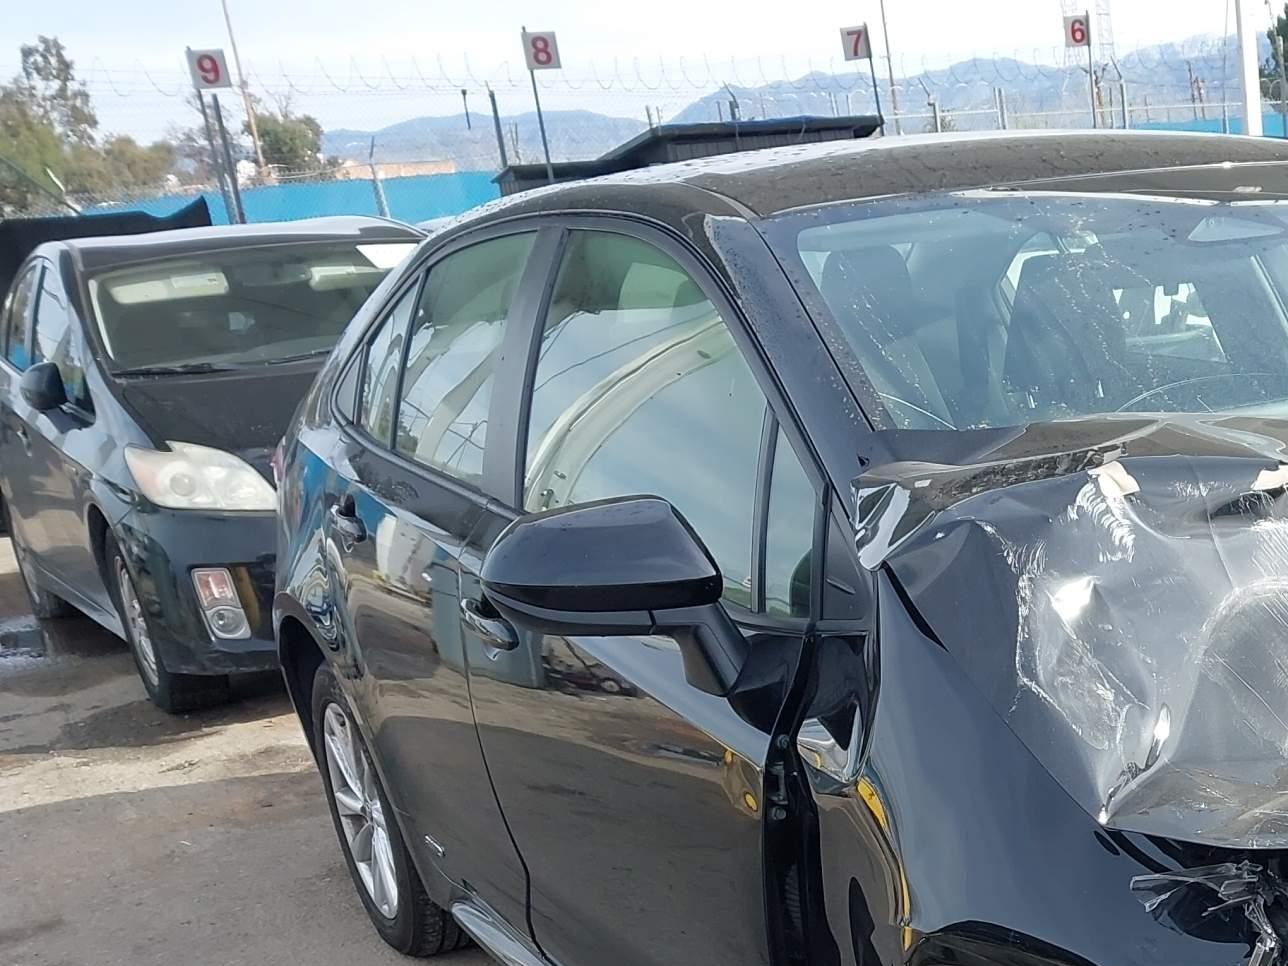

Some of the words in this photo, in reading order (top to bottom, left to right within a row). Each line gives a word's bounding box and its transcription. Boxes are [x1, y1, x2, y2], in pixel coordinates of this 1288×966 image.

[847, 30, 862, 57] 7
[1071, 19, 1085, 43] 6
[531, 36, 552, 65] 8
[197, 54, 220, 85] 9
